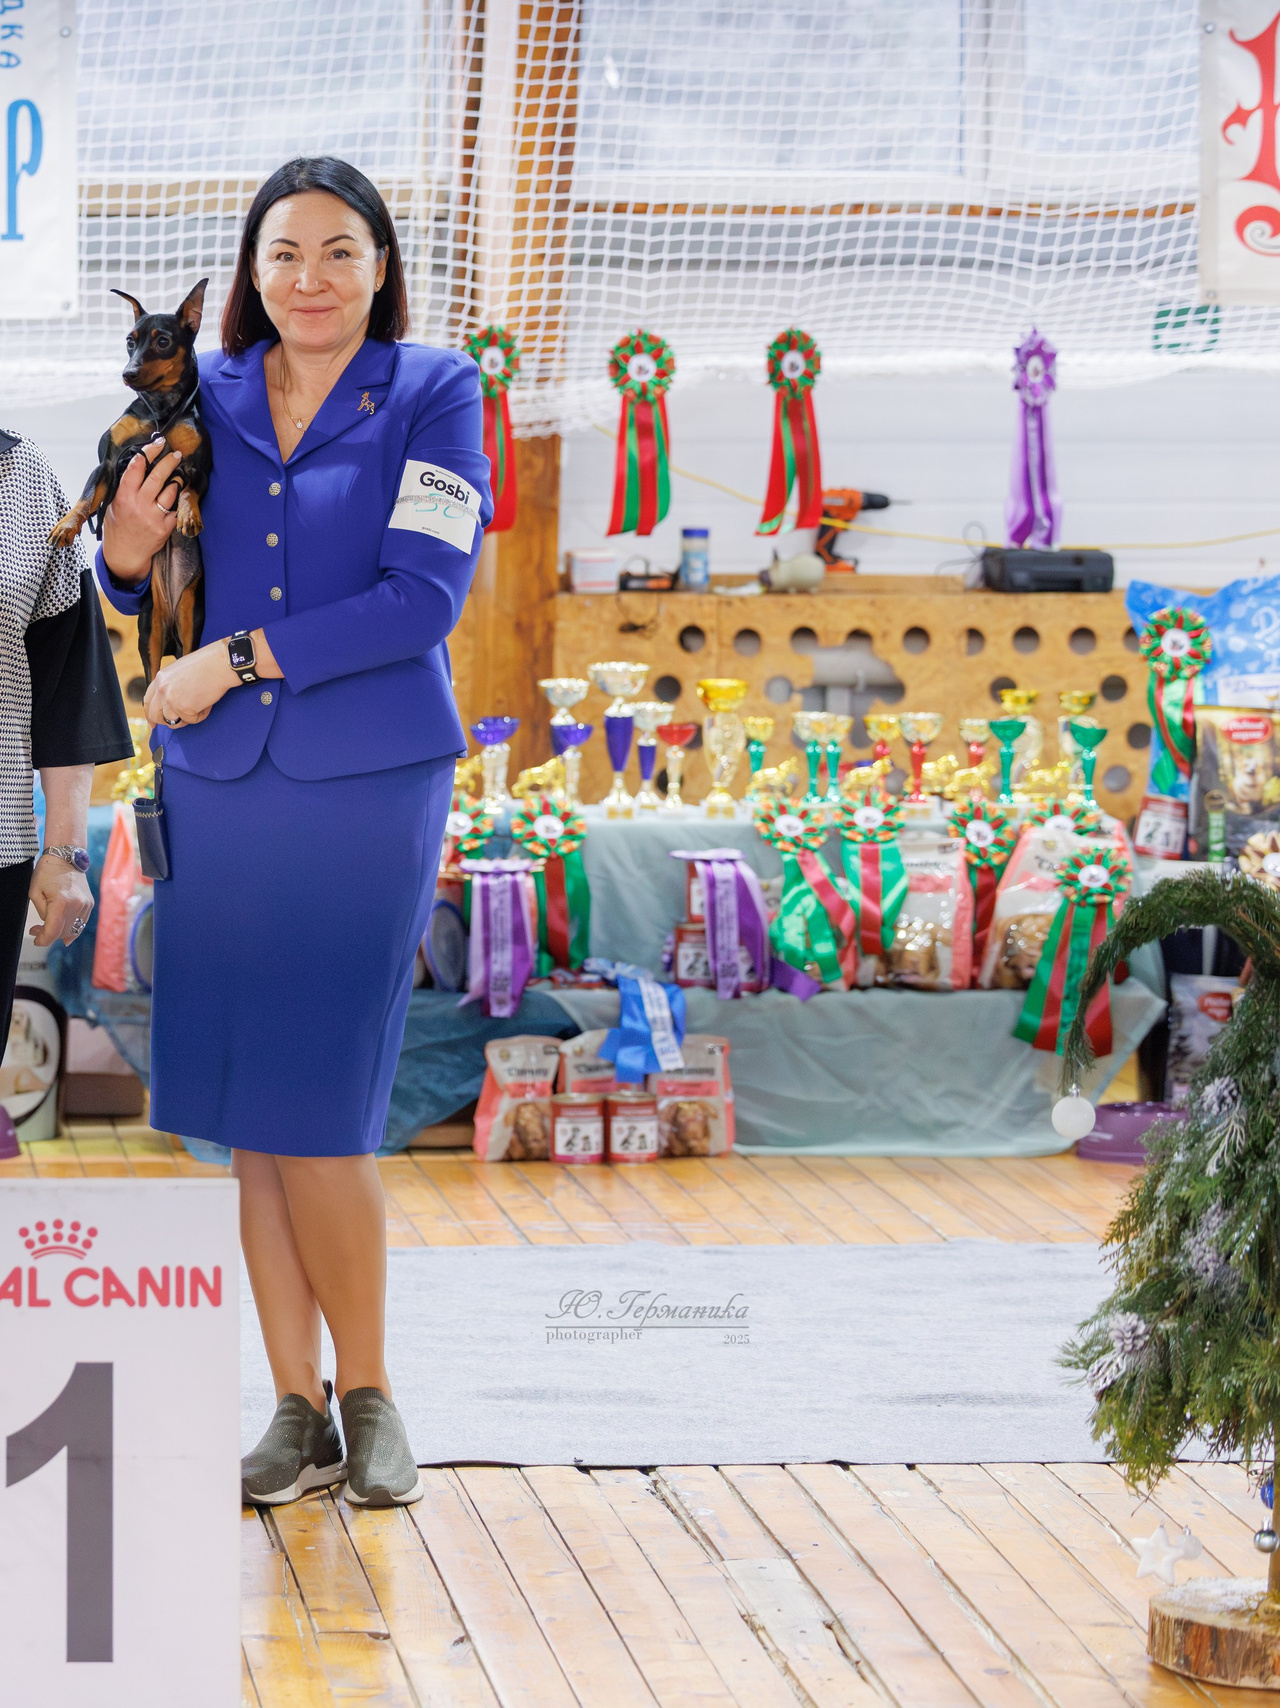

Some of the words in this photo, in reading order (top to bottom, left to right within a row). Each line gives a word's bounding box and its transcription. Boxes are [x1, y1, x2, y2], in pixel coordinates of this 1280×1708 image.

[419, 471, 470, 505] Gosbi
[63, 1265, 222, 1308] CANIN
[6, 1362, 114, 1663] 1
